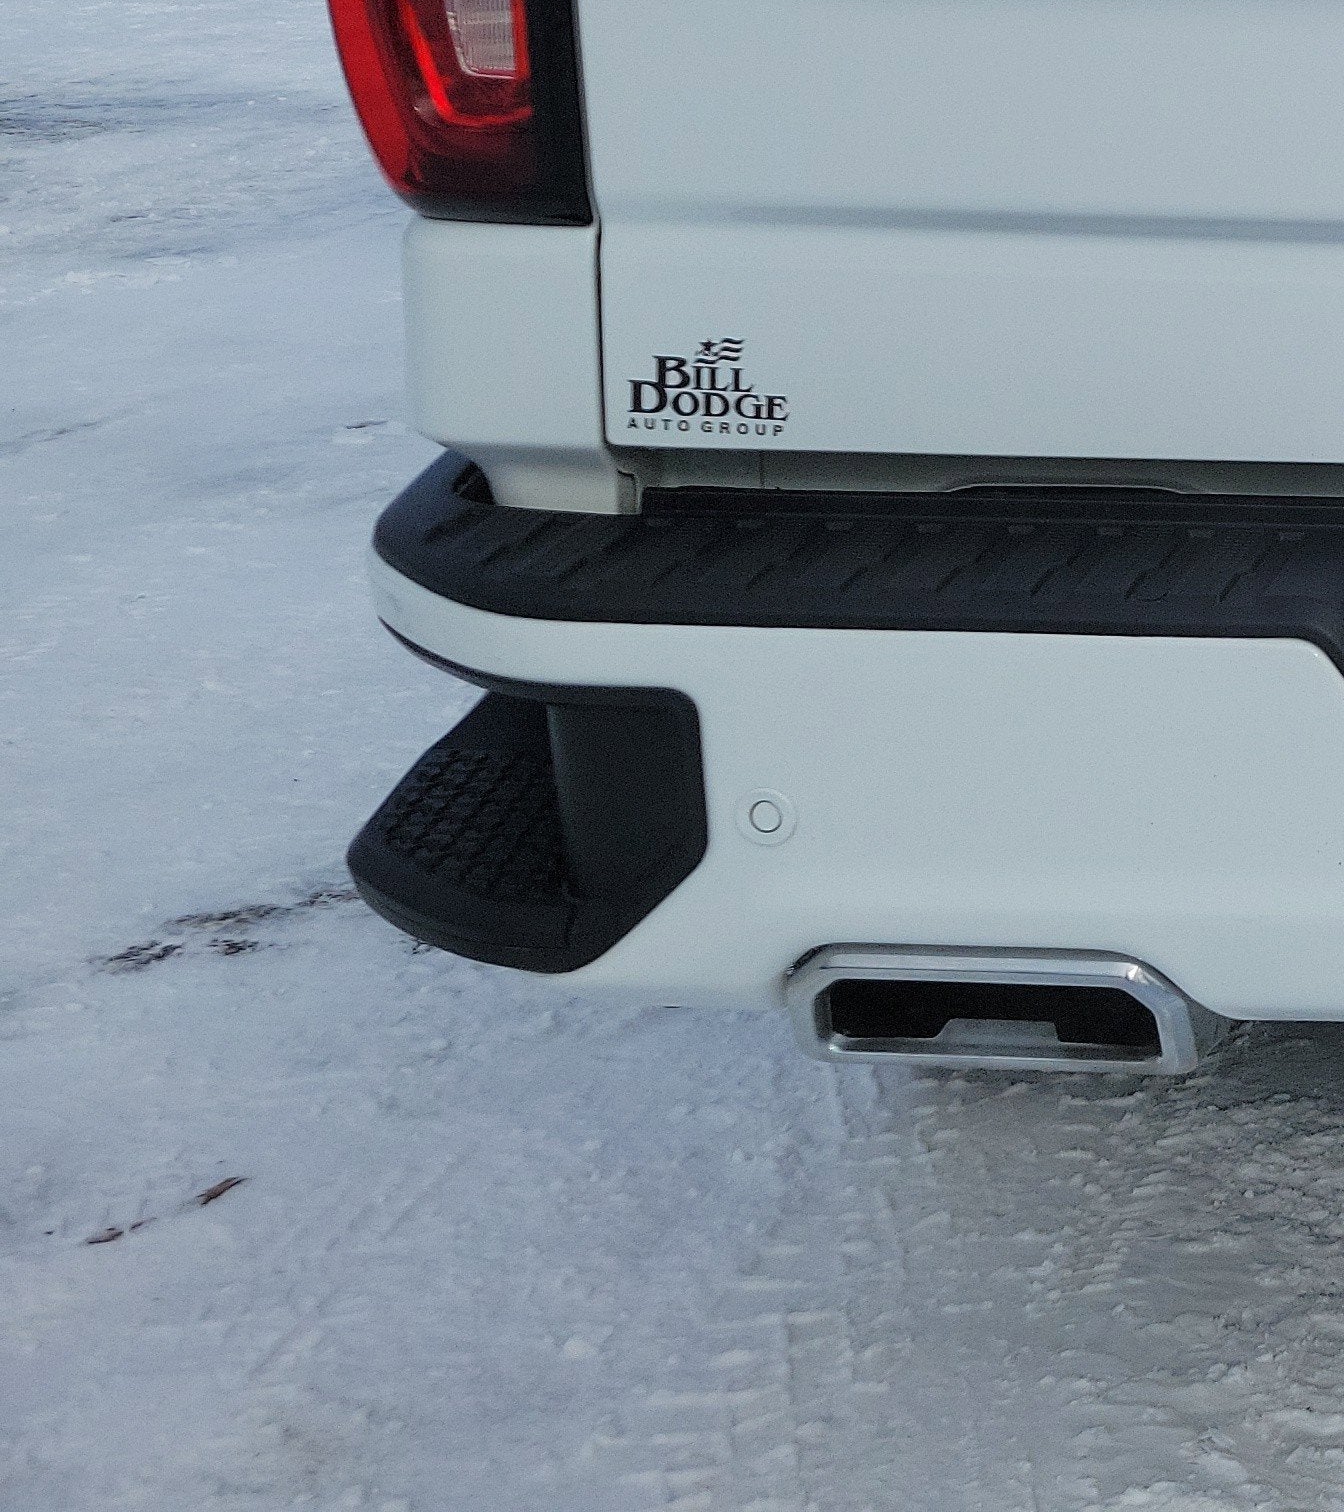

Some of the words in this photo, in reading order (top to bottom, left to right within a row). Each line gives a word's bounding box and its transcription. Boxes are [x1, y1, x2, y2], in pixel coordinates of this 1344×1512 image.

[652, 355, 755, 392] BILL
[627, 379, 790, 421] DODGE
[627, 417, 690, 432] AUTO
[701, 421, 784, 437] GROUP
